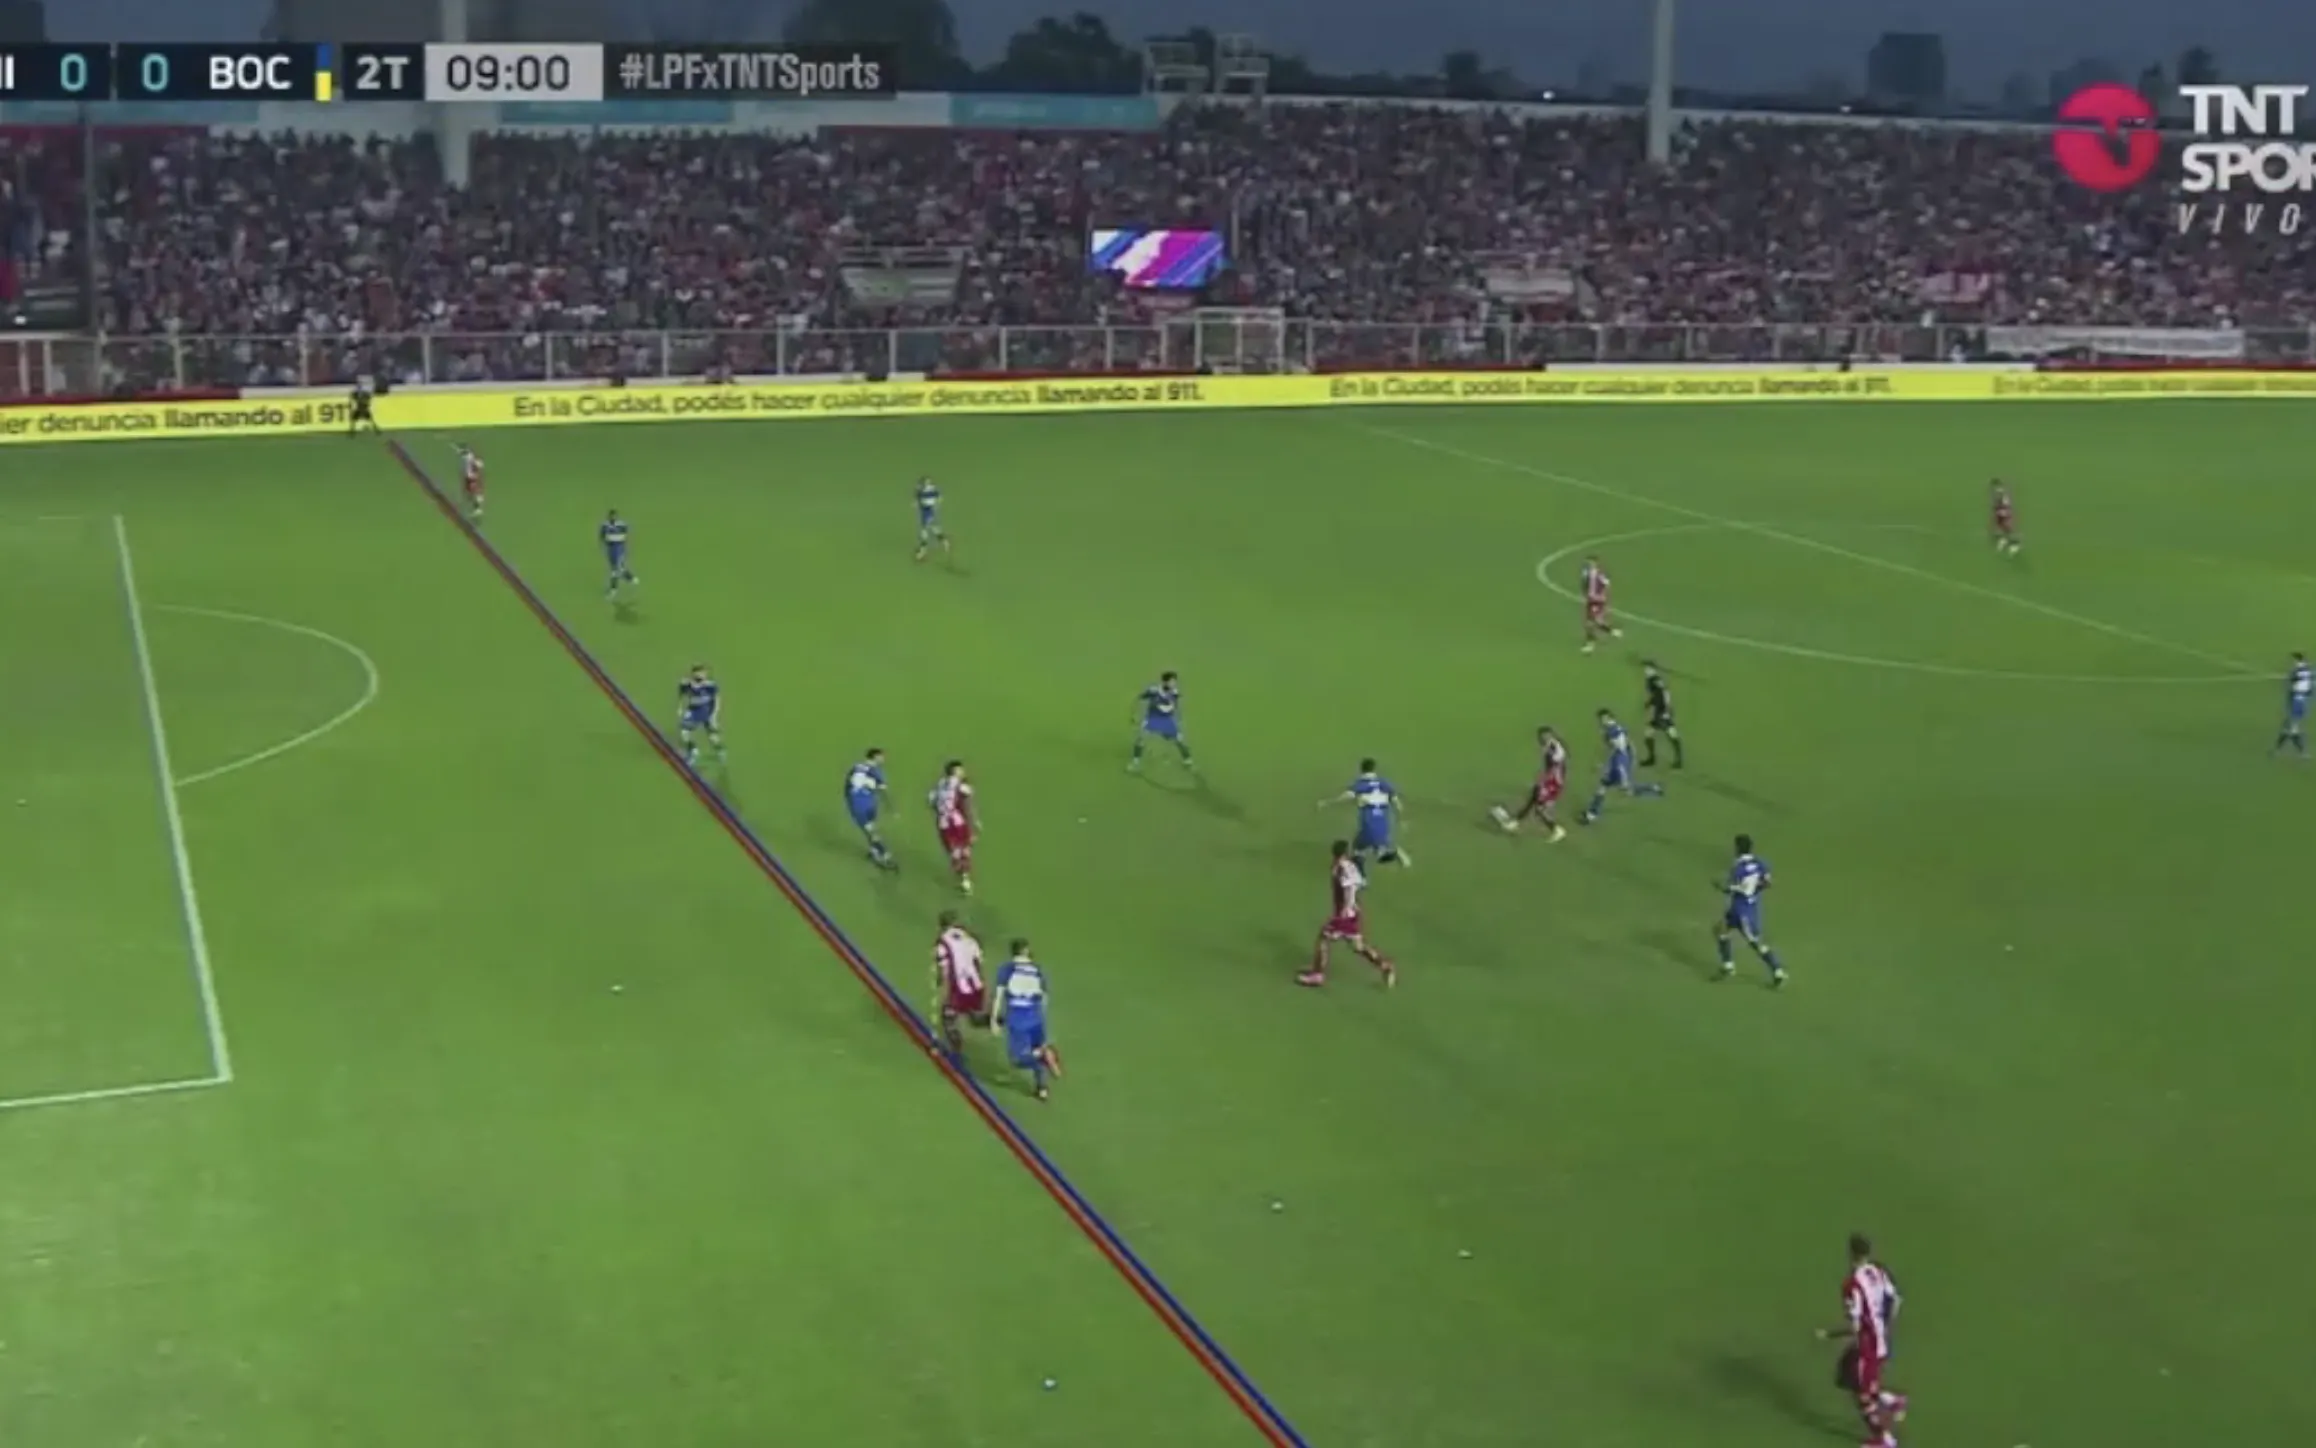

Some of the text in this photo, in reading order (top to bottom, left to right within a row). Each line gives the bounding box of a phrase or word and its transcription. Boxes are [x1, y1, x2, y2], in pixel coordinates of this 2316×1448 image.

[513, 395, 546, 417] En
[549, 395, 572, 416] la
[577, 393, 667, 416] Ciudad,
[751, 392, 816, 411] hacer
[1036, 384, 1139, 404] llamando
[1141, 384, 1162, 402] al
[38, 411, 157, 434] denuncia
[164, 406, 285, 428] llamando
[290, 404, 313, 425] al
